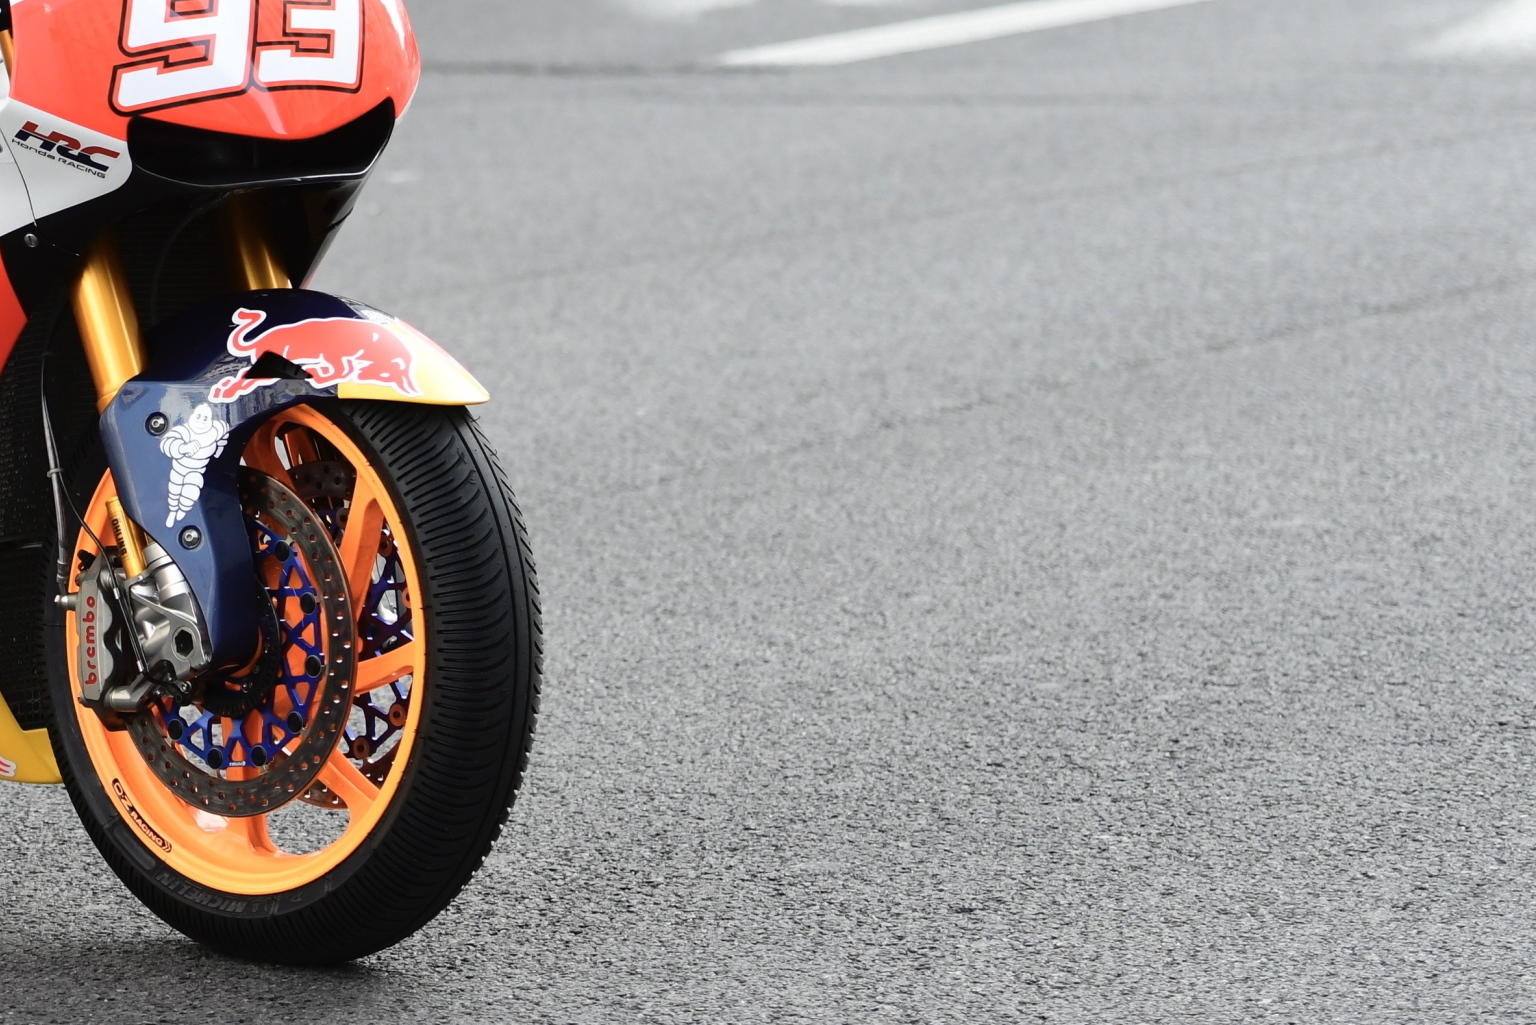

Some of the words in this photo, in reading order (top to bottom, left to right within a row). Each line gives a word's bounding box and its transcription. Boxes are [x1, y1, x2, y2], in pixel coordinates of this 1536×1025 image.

[11, 138, 56, 162] Honda
[57, 157, 106, 179] RACING
[14, 120, 120, 172] HRC
[83, 596, 96, 685] brembo
[131, 810, 164, 847] RACING
[153, 872, 249, 913] MICHELIN
